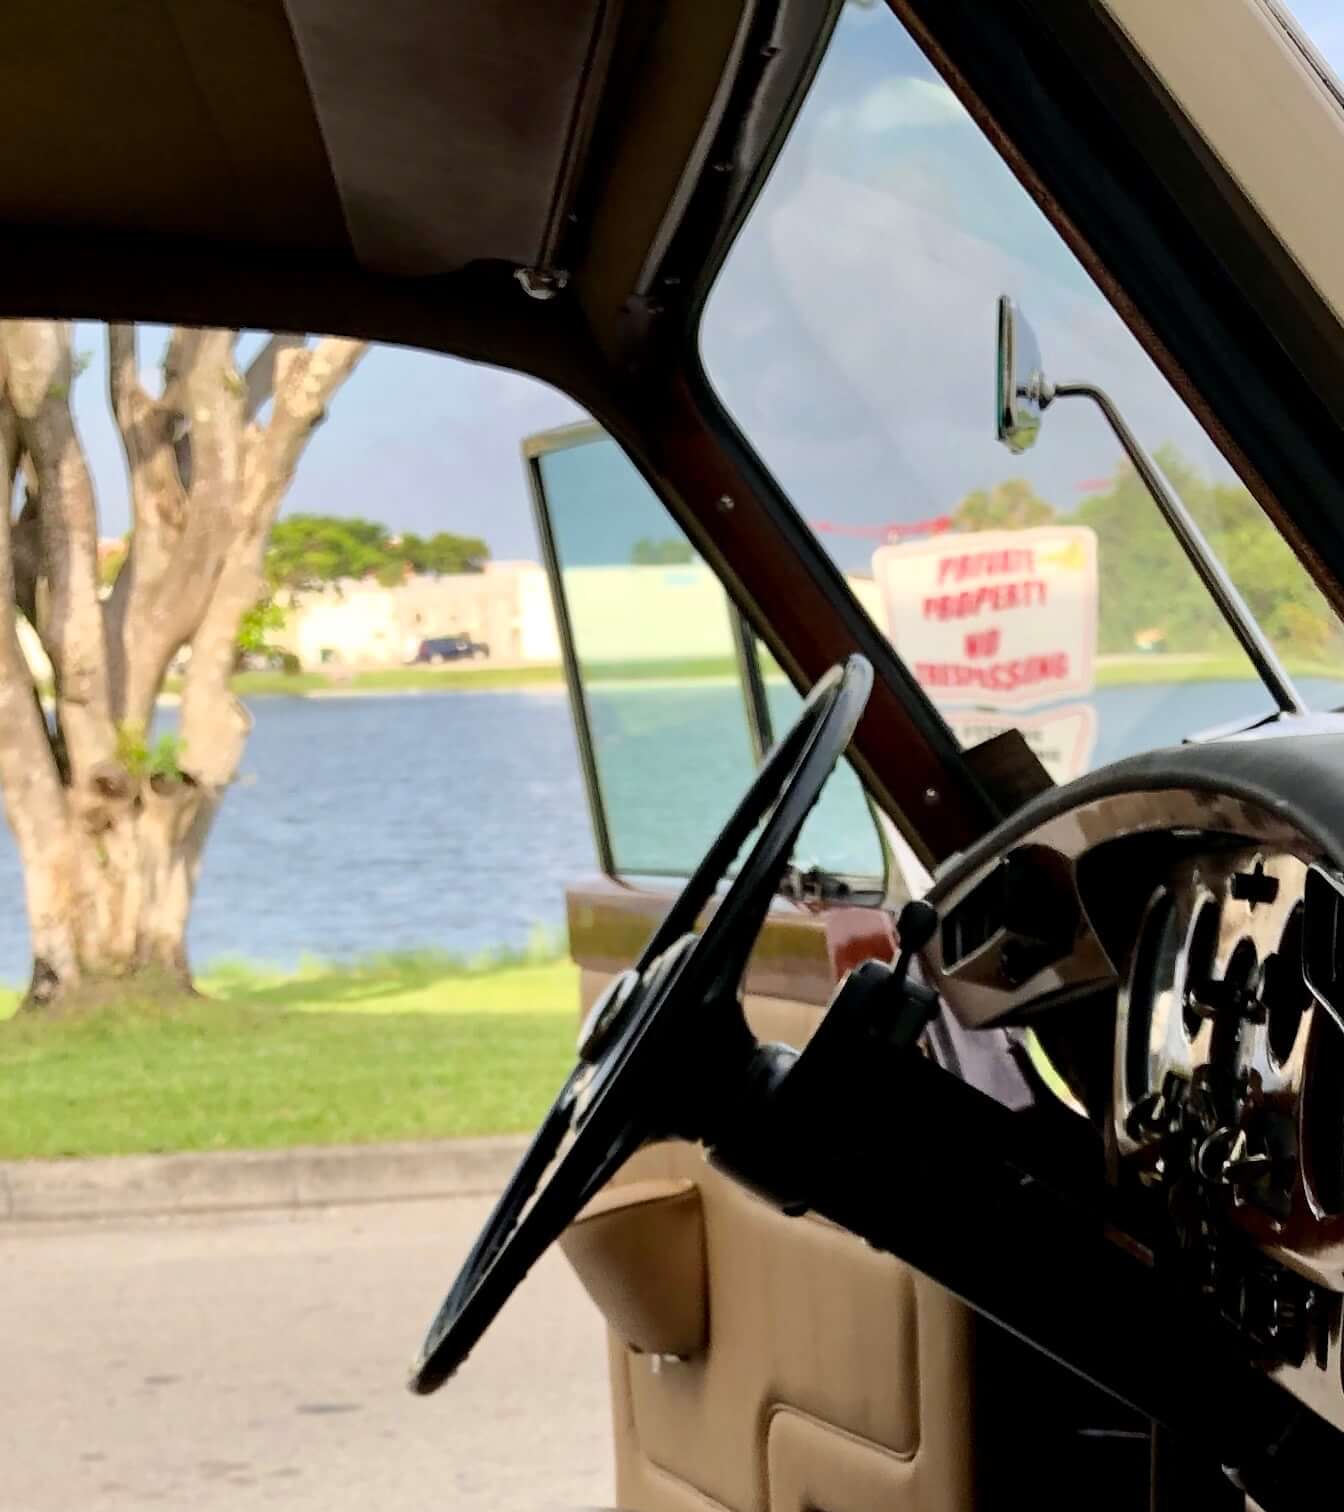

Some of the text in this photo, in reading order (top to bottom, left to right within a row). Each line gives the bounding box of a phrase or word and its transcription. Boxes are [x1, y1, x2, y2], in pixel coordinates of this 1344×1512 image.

[939, 550, 1034, 582] PRIVATE
[923, 581, 1046, 620] PROPERTY
[965, 629, 1000, 657] NO
[916, 653, 1067, 689] TRESPASSING
